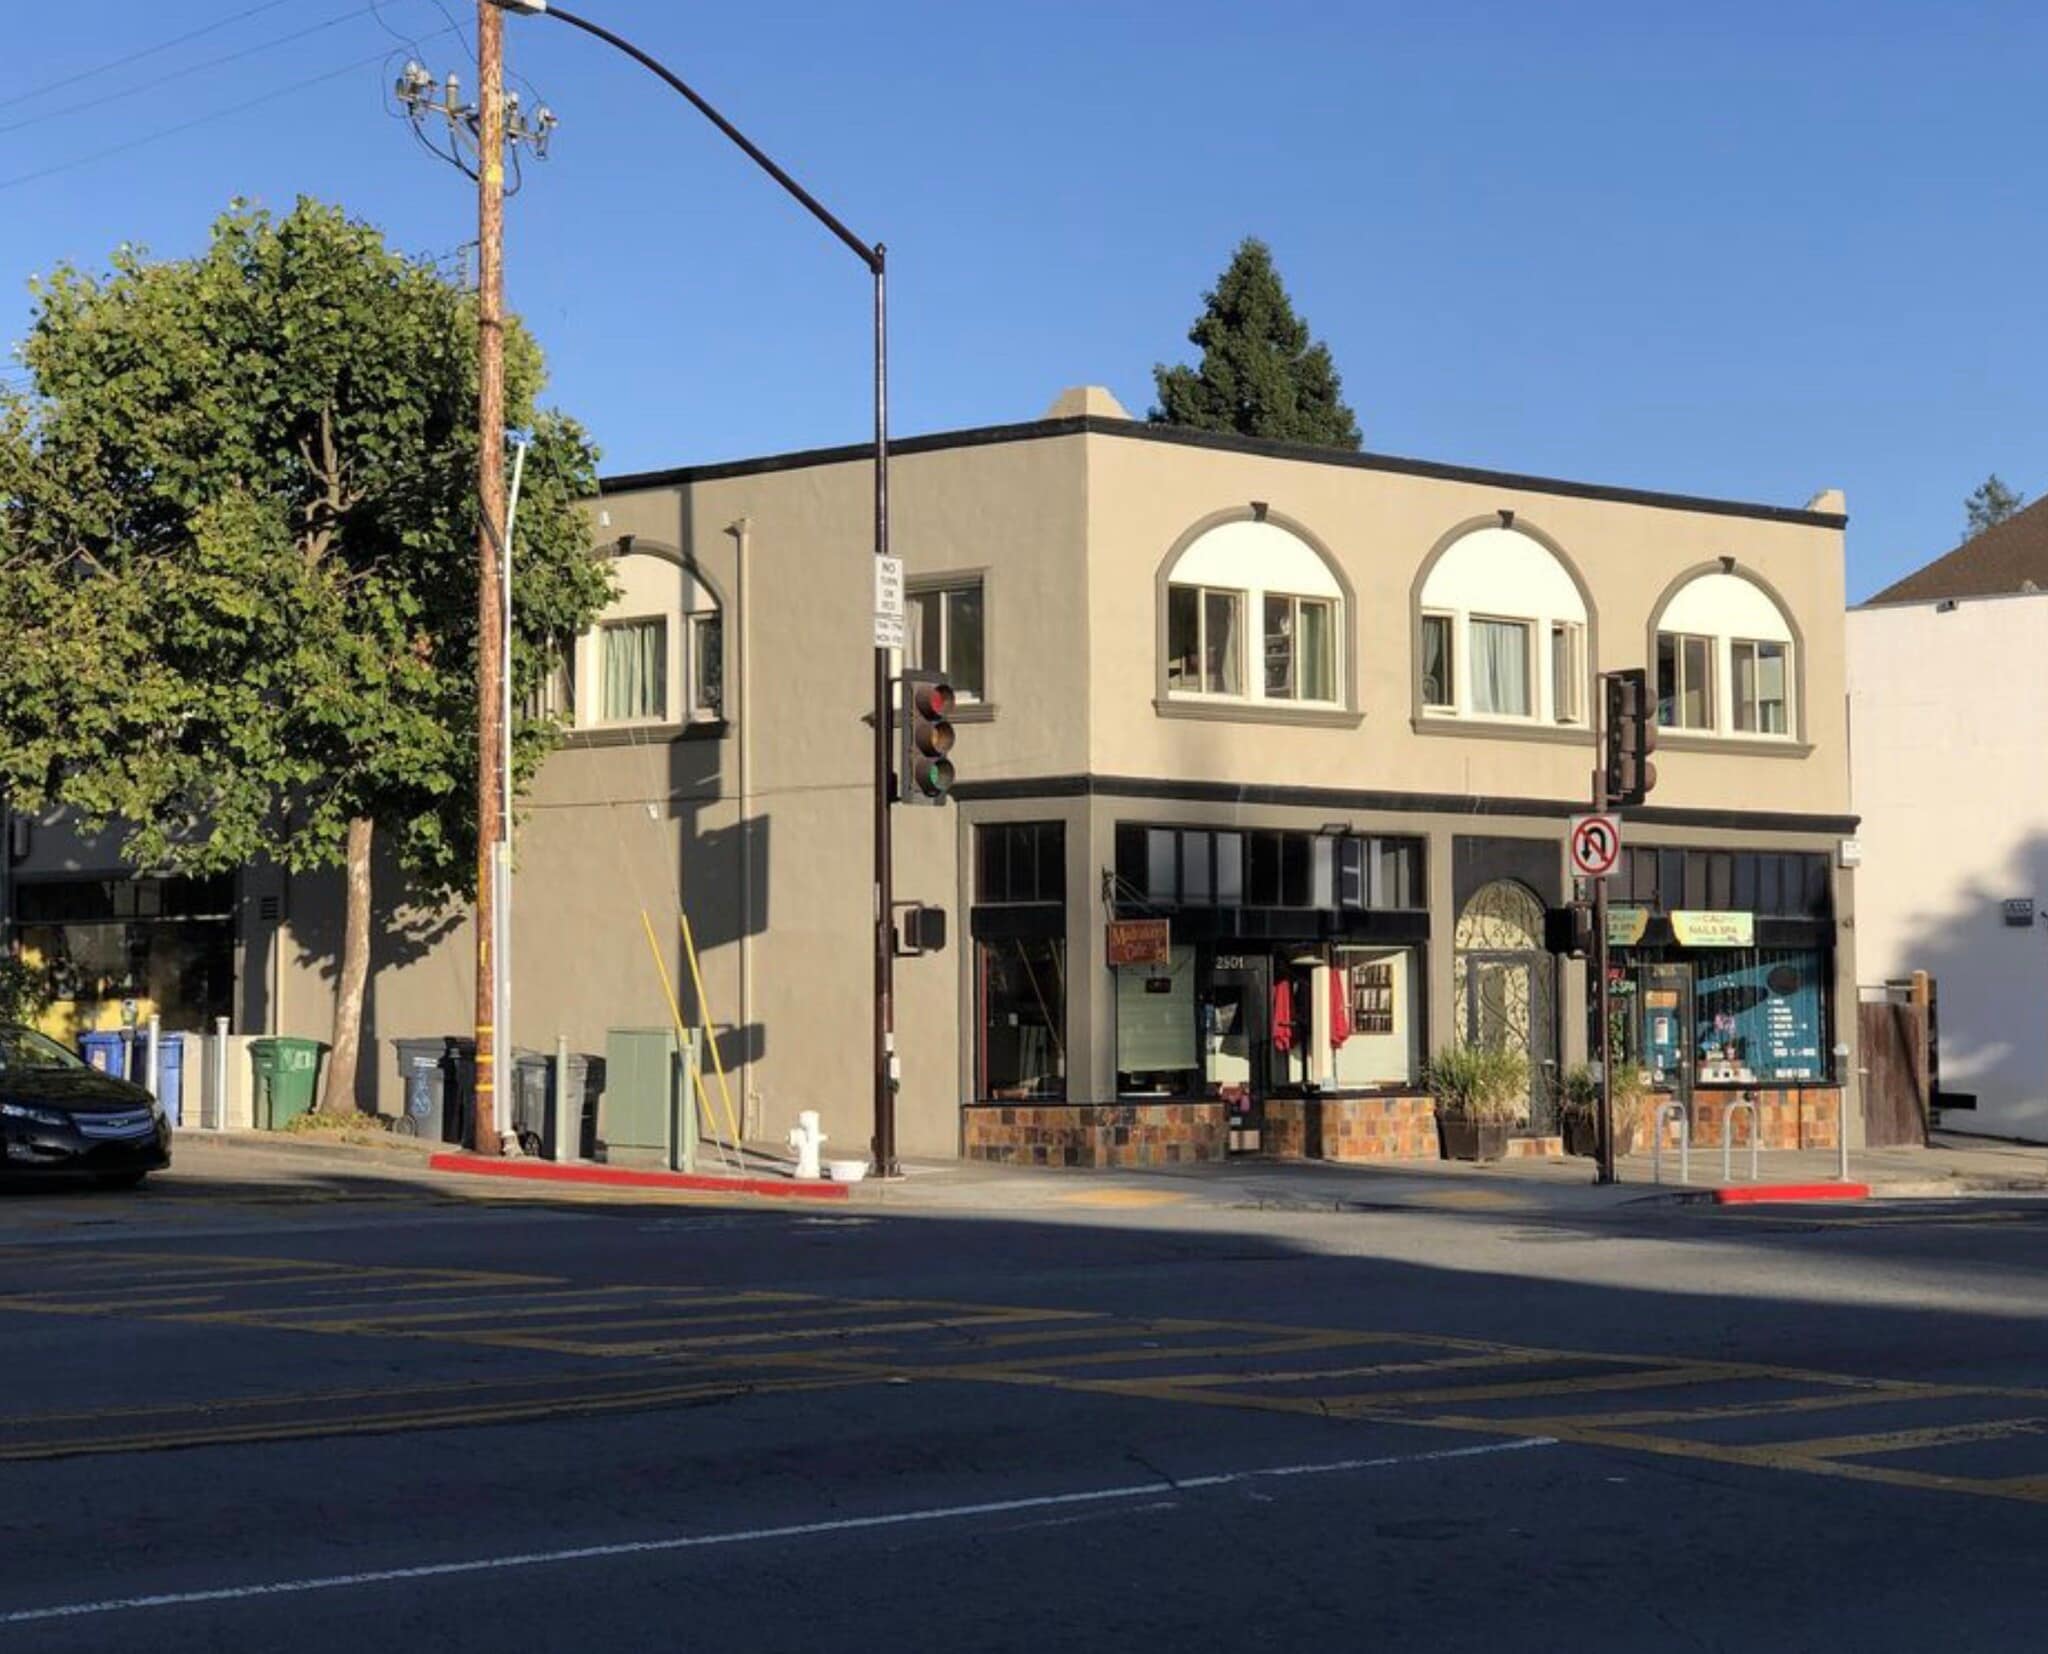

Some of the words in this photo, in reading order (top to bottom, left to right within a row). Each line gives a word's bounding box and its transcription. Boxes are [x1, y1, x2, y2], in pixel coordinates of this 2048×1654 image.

[881, 562, 896, 574] NO
[880, 575, 898, 587] TURN
[883, 589, 894, 598] ON
[1215, 955, 1244, 969] 2501
